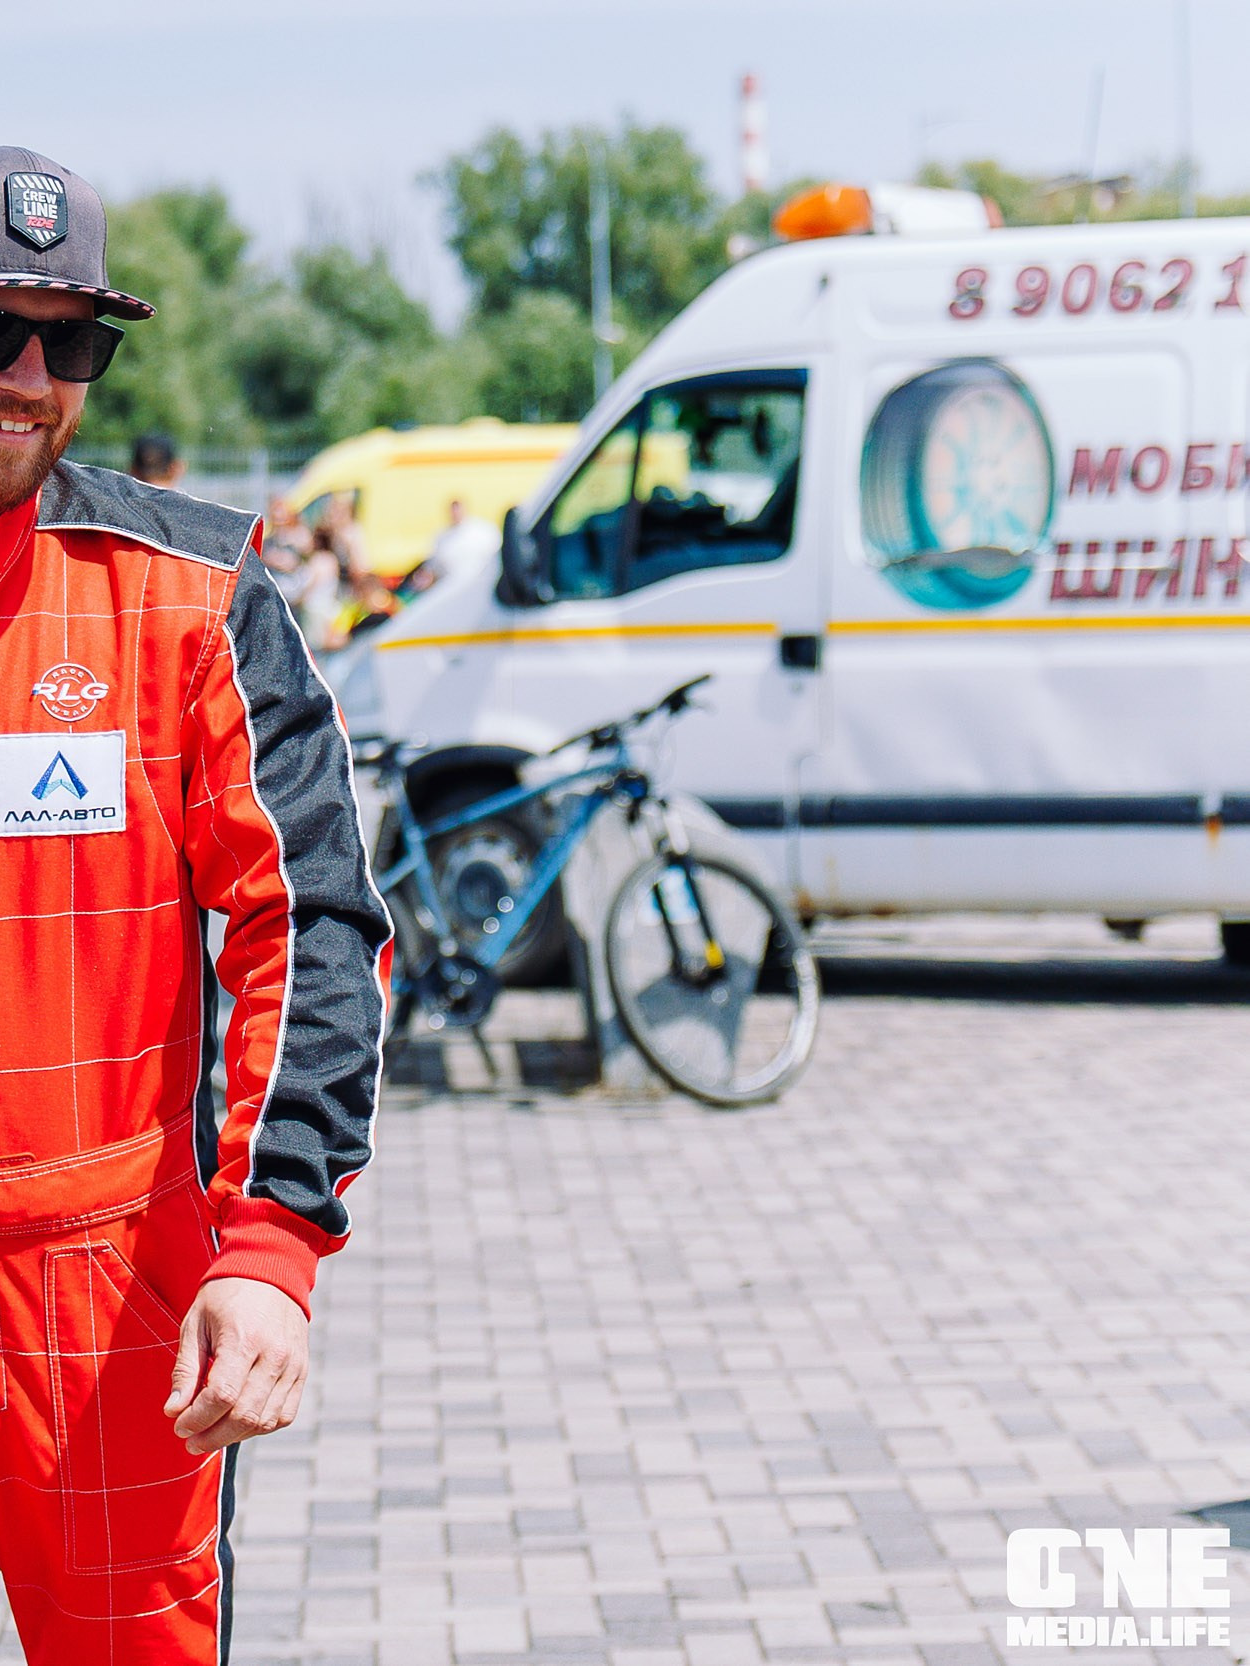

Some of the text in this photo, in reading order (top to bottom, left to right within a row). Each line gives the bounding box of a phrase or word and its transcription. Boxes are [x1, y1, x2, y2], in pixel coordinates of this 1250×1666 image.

[23, 188, 57, 205] CREW
[23, 201, 59, 220] LINE
[949, 253, 1249, 319] 8 9062 1
[31, 682, 110, 701] RLG
[51, 705, 89, 717] WEAR
